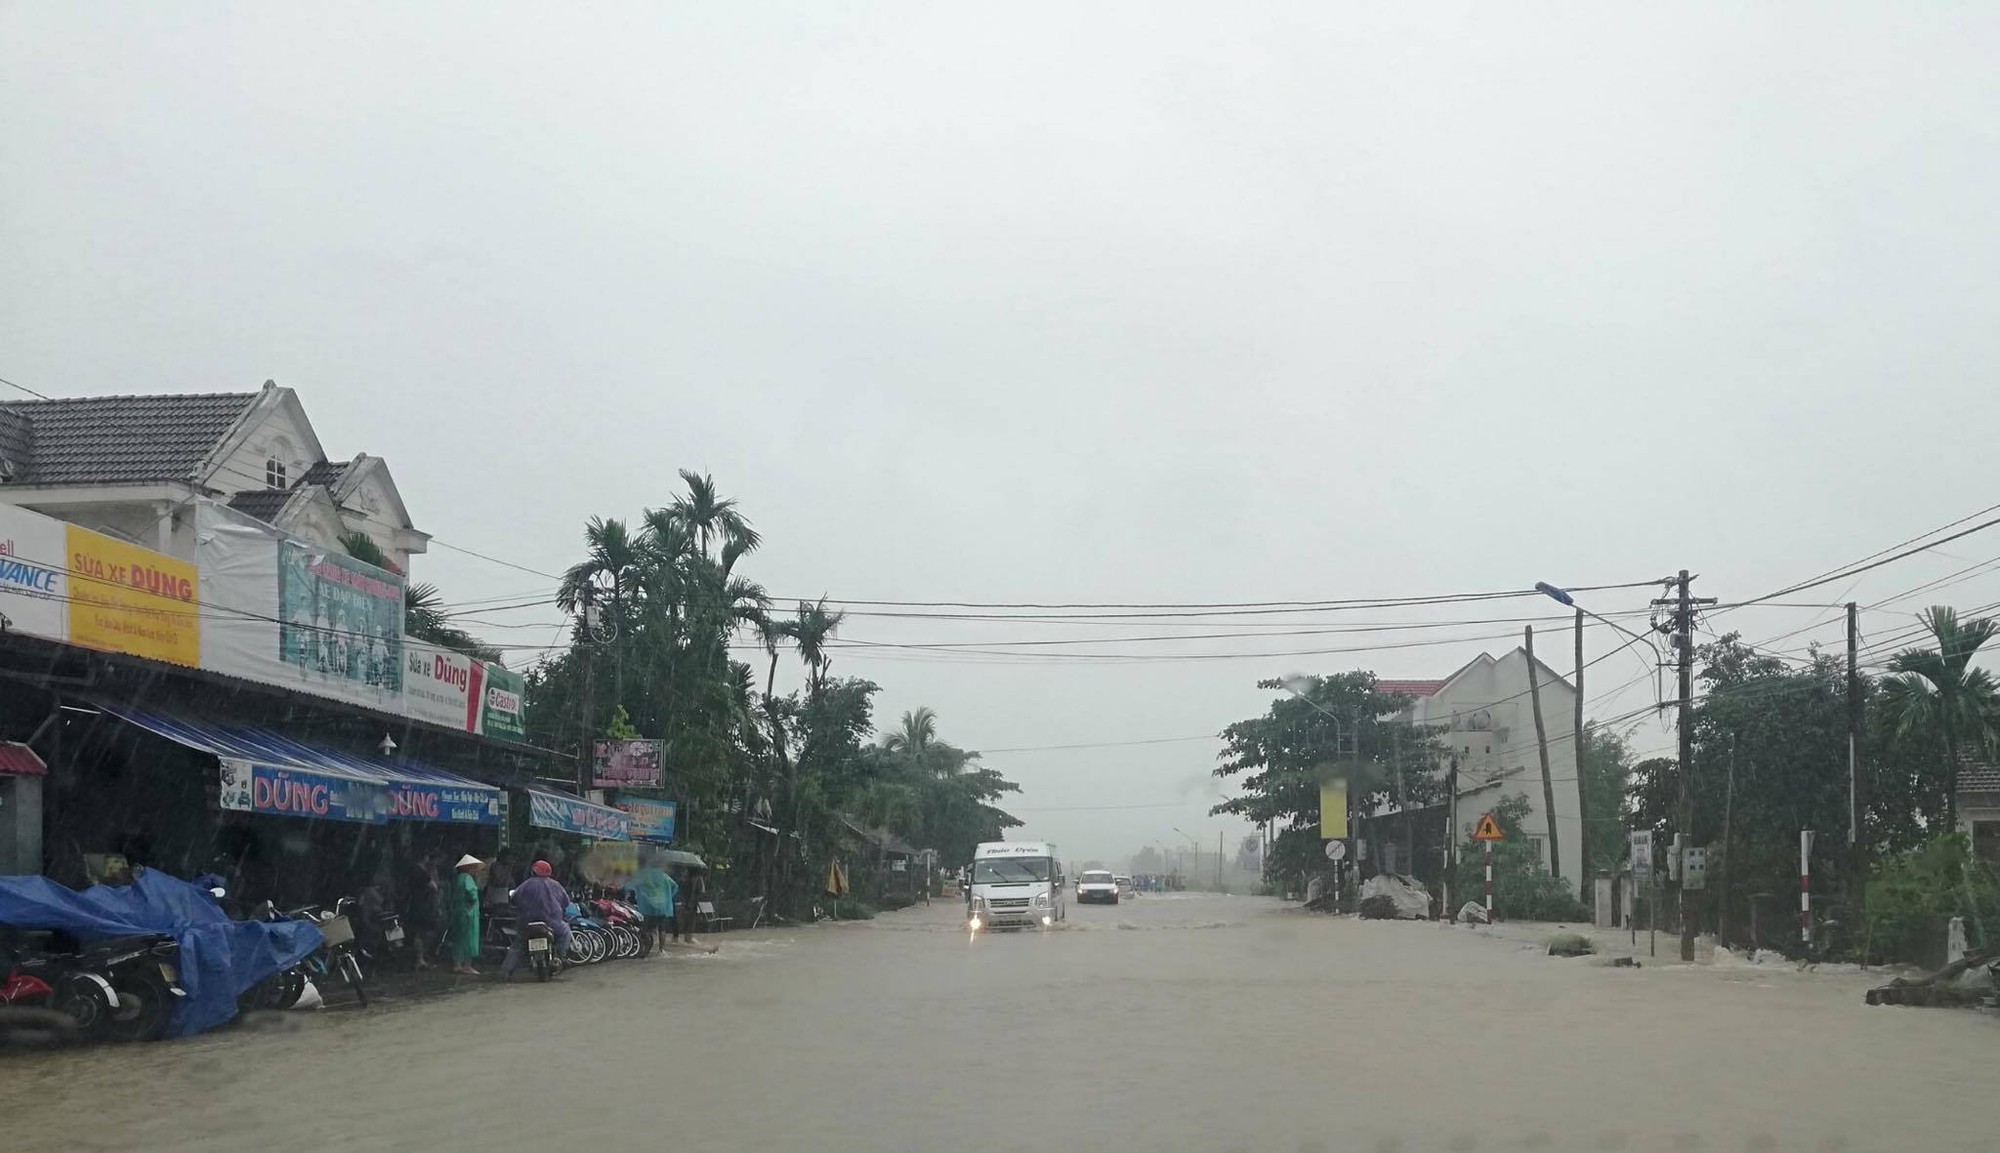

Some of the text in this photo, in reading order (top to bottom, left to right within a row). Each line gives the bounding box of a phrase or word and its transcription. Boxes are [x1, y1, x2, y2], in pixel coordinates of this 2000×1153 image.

[131, 562, 193, 601] DŨNG
[434, 654, 467, 693] Dũng
[254, 771, 329, 815] DŨNG
